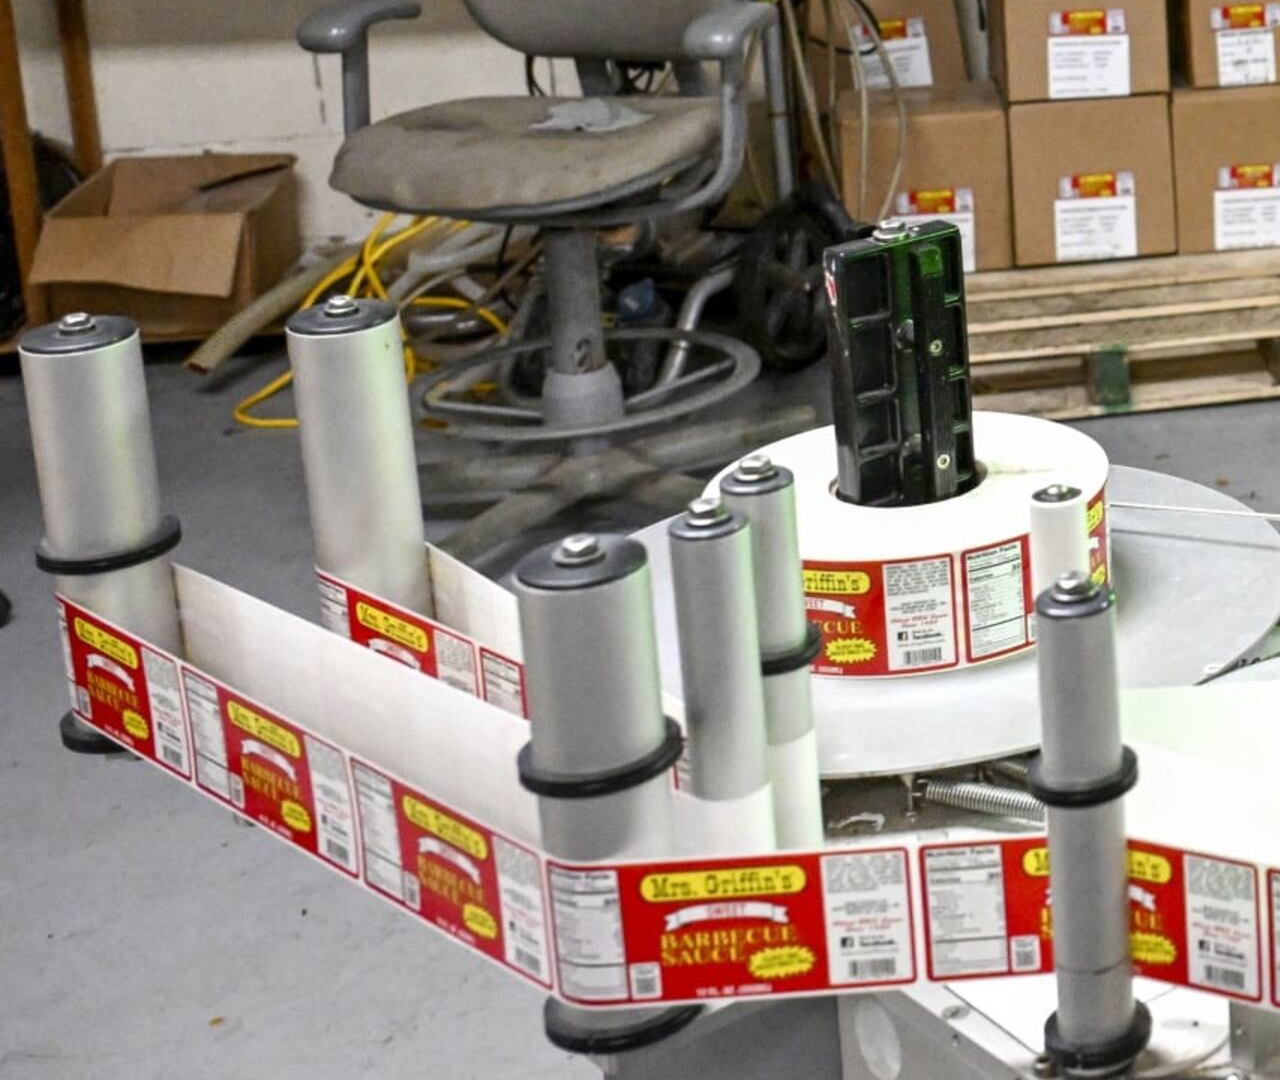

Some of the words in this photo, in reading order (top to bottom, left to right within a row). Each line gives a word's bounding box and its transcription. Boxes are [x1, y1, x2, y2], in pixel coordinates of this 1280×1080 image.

[651, 876, 699, 899] Mrs.
[704, 869, 793, 896] Griffin's
[660, 924, 798, 951] BARBECUE
[660, 944, 746, 967] SAUCE
